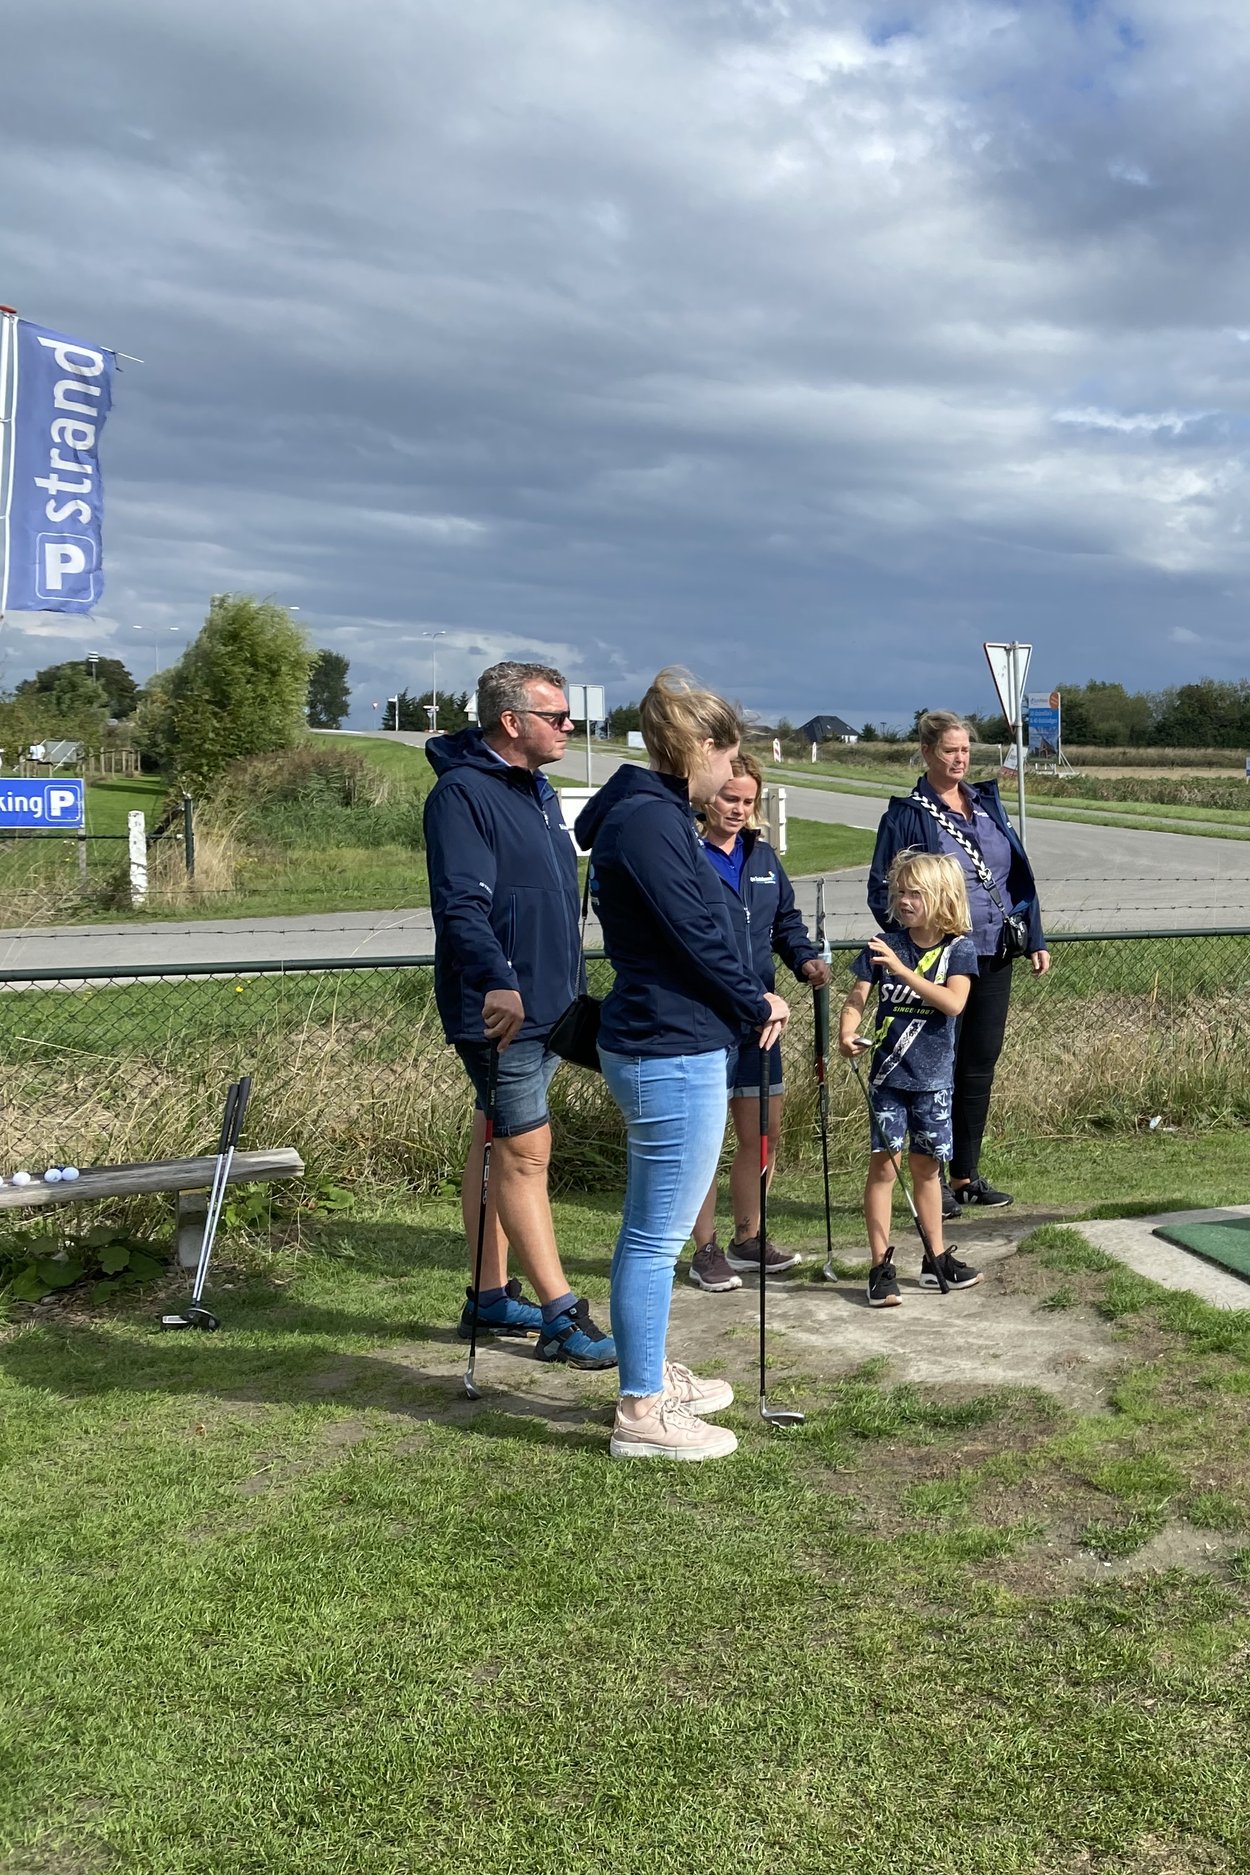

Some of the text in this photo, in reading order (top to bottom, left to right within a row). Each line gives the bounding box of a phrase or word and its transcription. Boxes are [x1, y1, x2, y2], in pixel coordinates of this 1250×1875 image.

[33, 336, 105, 590] P strand
[50, 790, 75, 817] P
